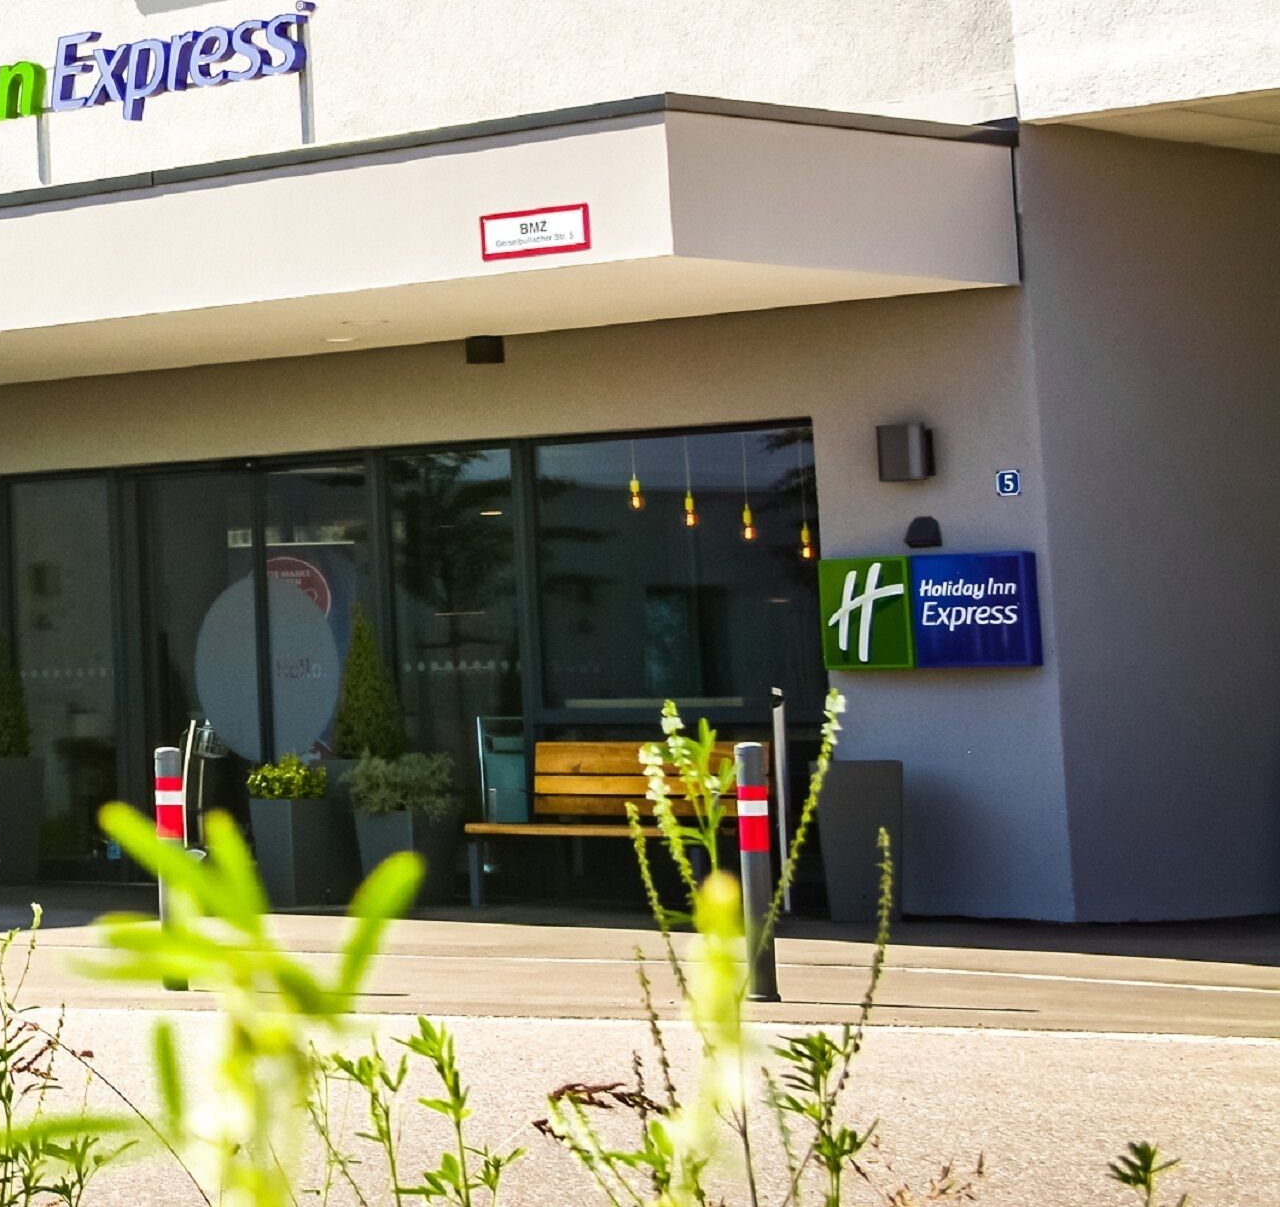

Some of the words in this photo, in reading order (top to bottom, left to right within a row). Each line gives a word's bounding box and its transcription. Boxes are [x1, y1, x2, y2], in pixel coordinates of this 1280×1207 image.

[51, 12, 310, 121] Express
[519, 220, 547, 235] BMZ
[1003, 474, 1014, 492] 5
[919, 578, 985, 600] Holiday
[987, 577, 1017, 595] Inn
[922, 601, 1018, 632] Express
